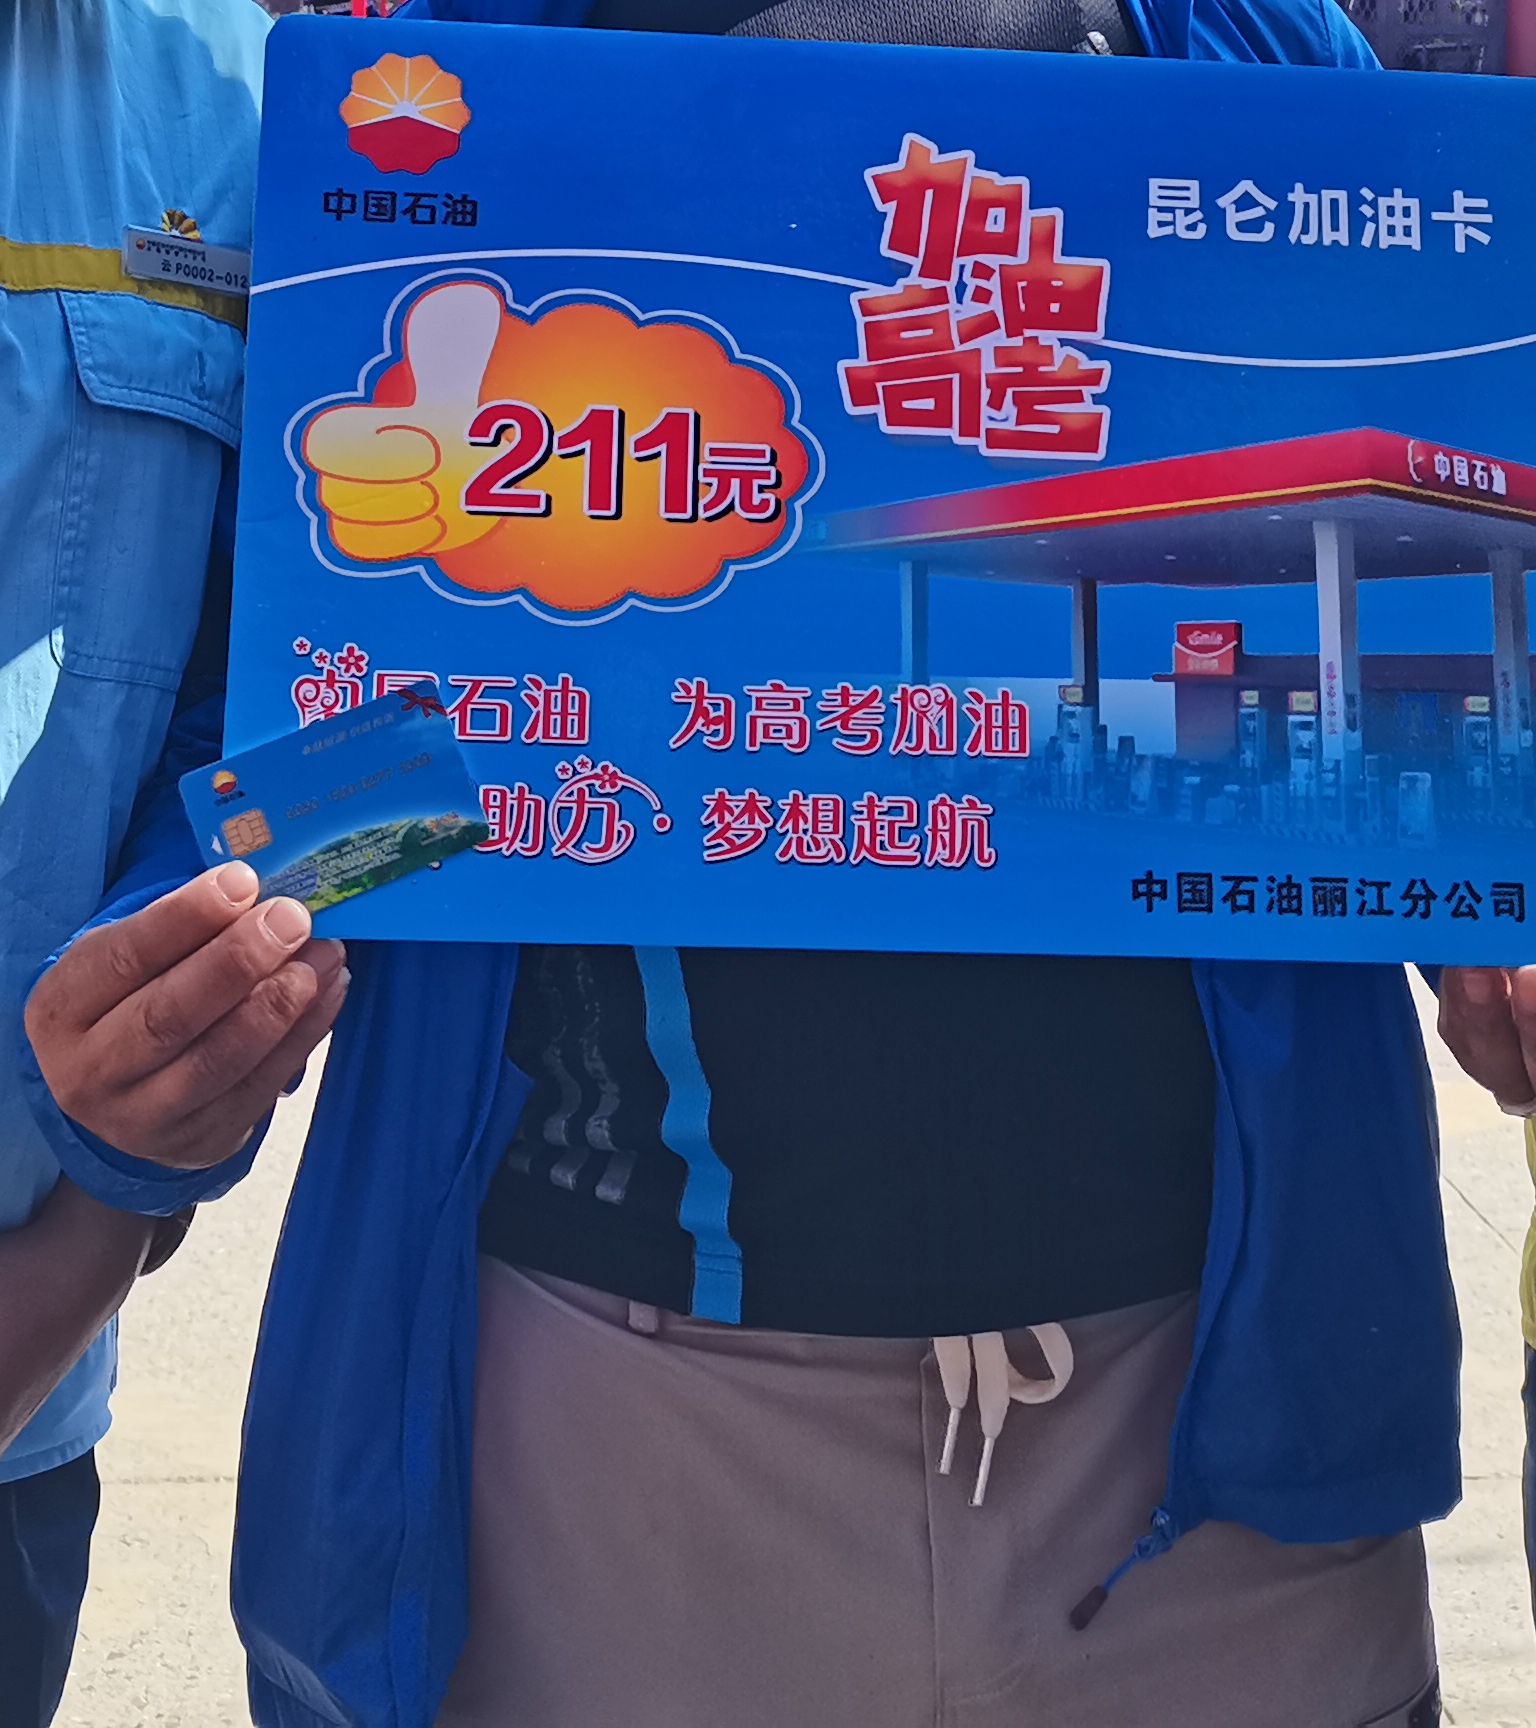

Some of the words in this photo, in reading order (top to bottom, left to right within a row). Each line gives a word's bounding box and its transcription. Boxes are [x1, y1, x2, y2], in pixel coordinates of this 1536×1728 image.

[322, 187, 479, 228] 中国石油
[1146, 177, 1494, 254] 昆仑加油卡
[460, 399, 783, 523] 211元
[669, 676, 1031, 759] 为高考加油
[699, 788, 998, 869] 梦想起航
[1131, 869, 1527, 924] 中国石油丽江分公司
